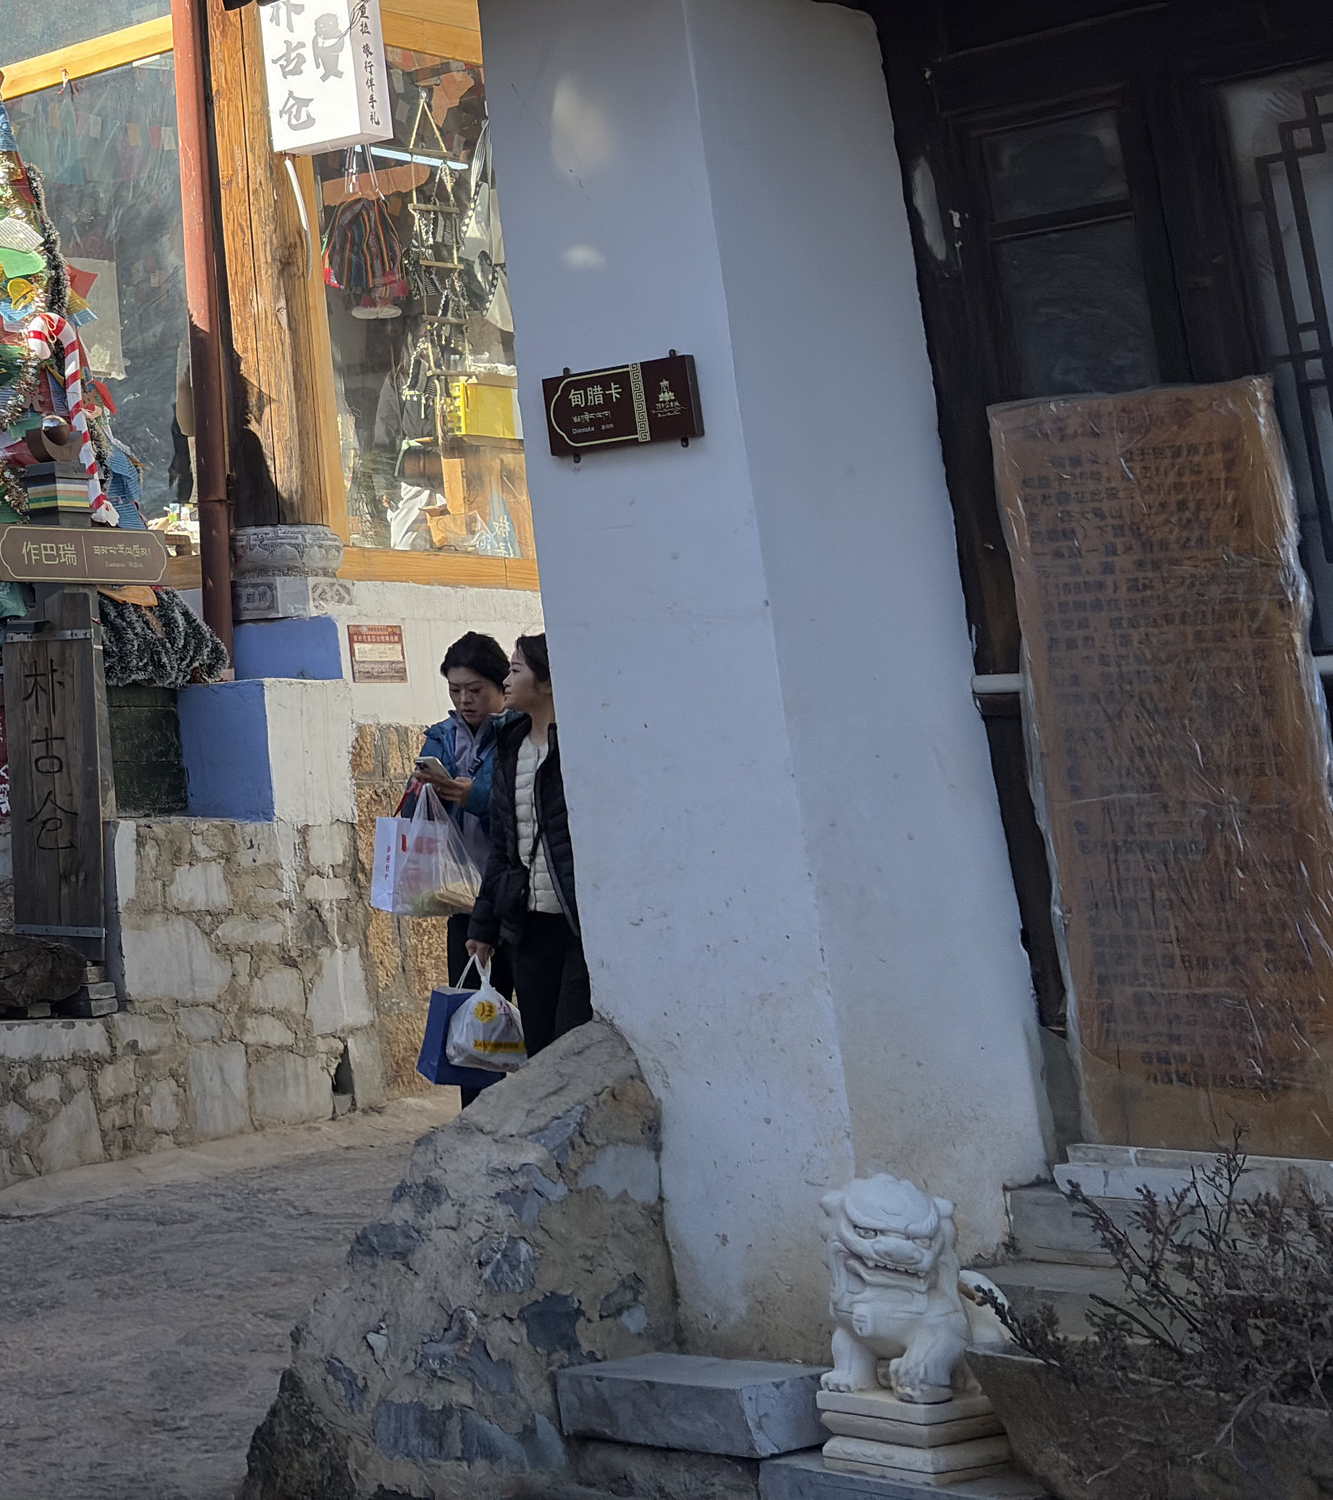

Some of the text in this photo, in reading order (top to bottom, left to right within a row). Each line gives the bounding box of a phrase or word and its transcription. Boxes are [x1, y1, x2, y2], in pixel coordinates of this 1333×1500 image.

[568, 381, 623, 408] 甸腊卡
[21, 540, 77, 566] 作巴瑞
